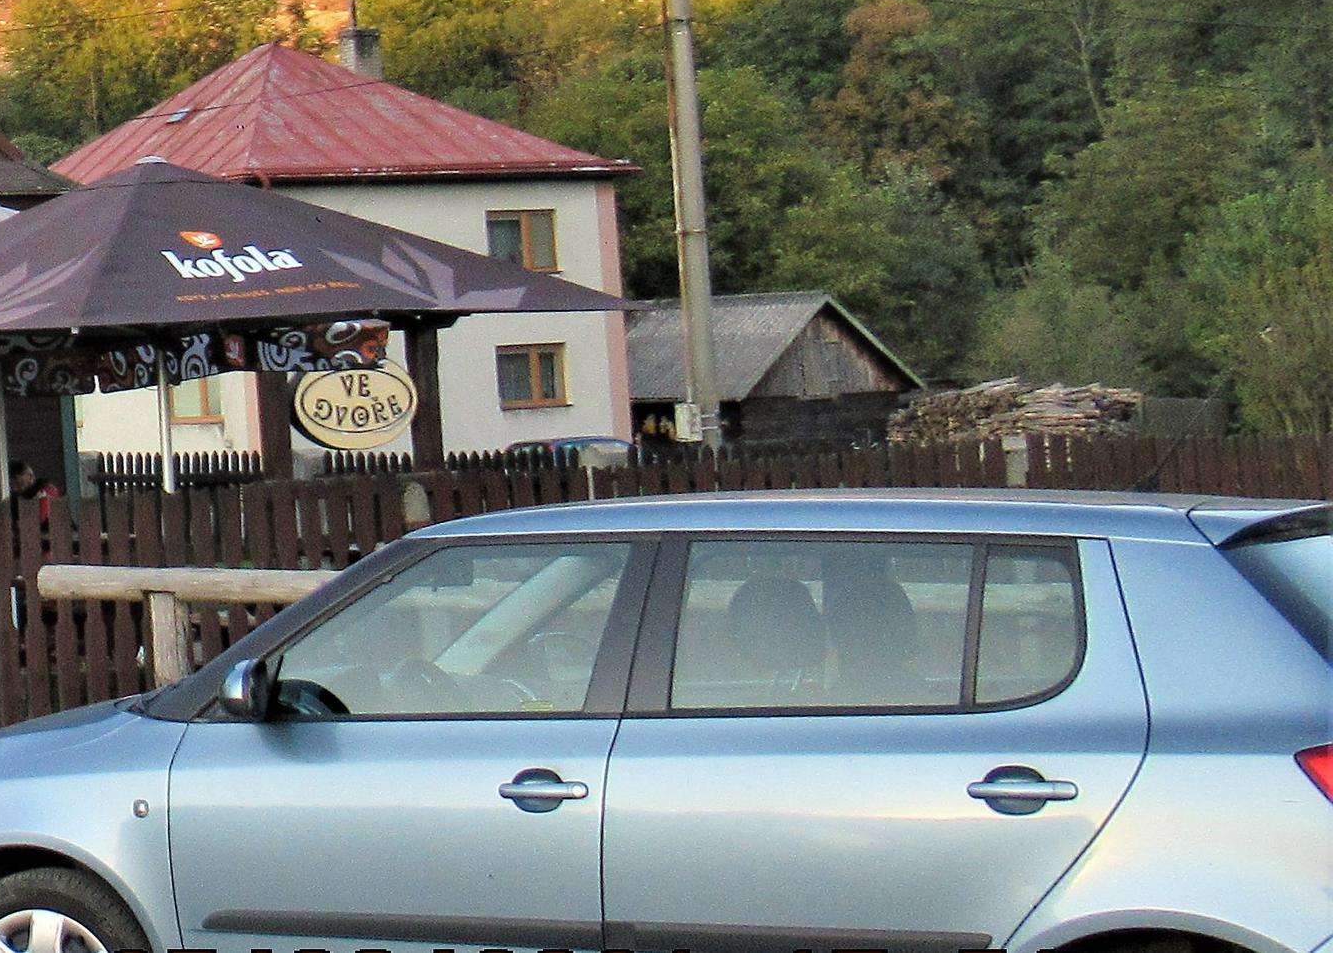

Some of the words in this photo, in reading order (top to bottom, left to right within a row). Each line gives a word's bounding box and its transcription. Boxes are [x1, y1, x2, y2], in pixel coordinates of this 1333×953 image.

[161, 244, 303, 283] kofola
[340, 373, 373, 398] VE
[313, 394, 403, 430] DVOŘE
